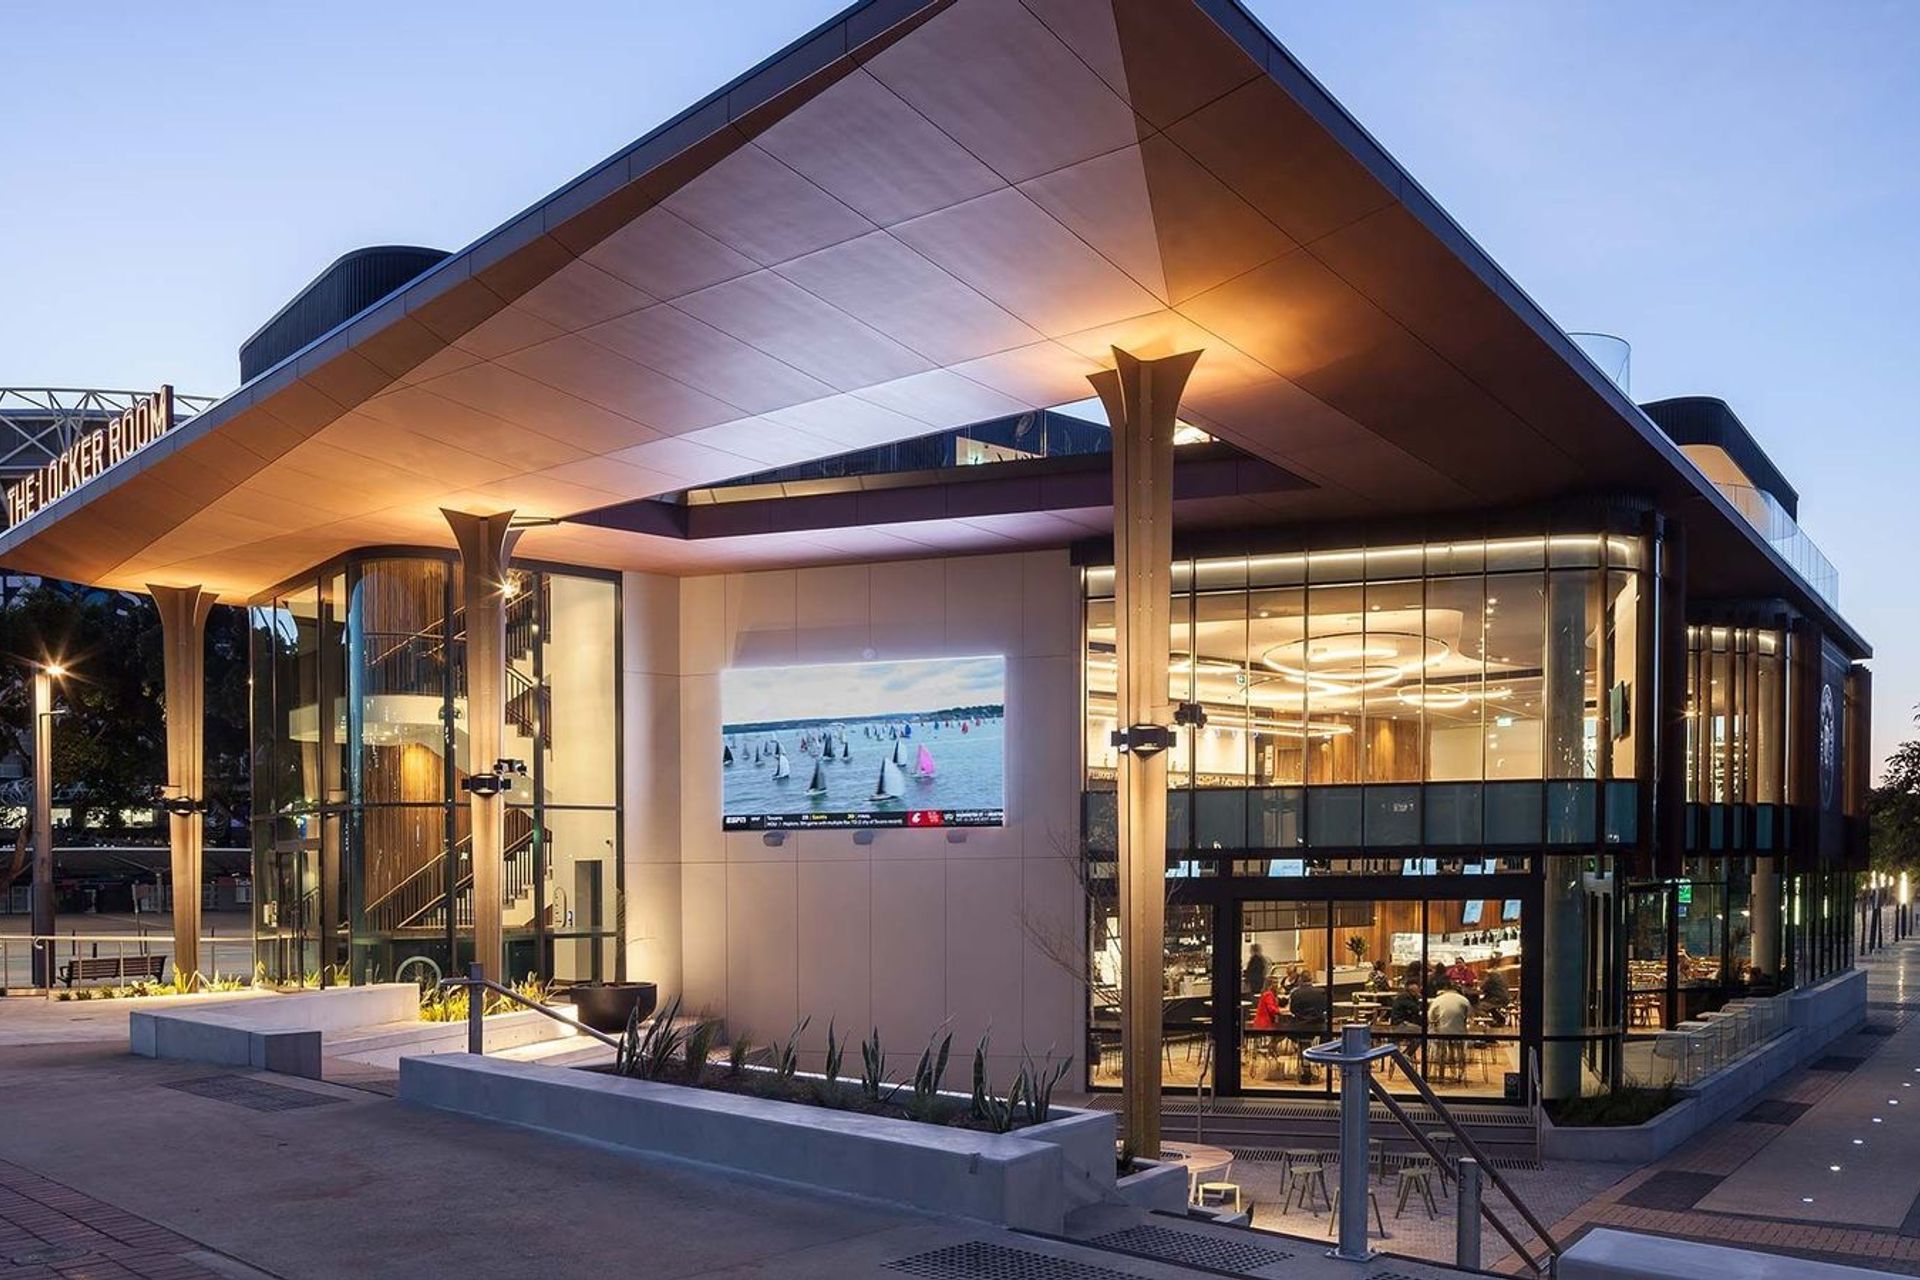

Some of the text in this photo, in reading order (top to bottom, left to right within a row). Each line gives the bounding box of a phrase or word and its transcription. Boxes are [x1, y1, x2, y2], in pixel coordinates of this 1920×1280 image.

[7, 385, 169, 528] THE LOCKER ROOM
